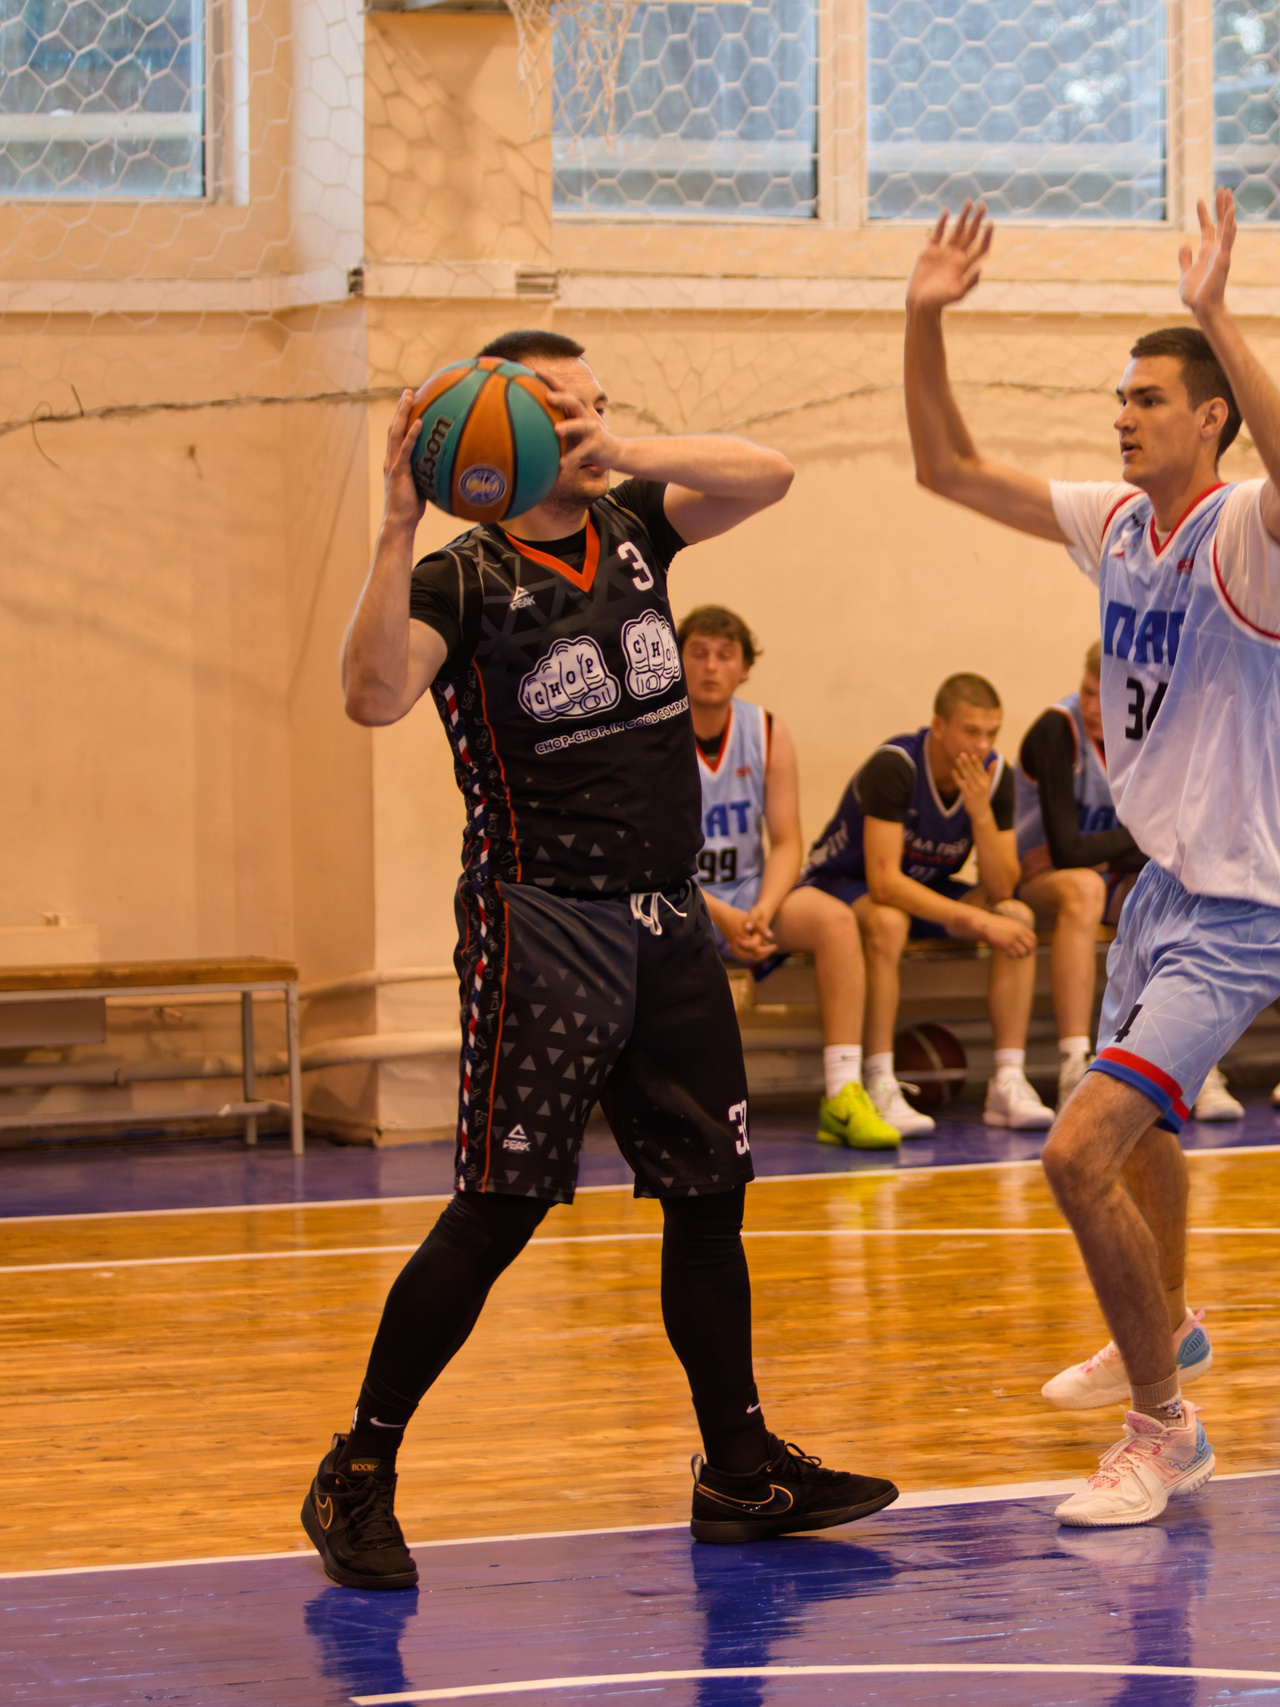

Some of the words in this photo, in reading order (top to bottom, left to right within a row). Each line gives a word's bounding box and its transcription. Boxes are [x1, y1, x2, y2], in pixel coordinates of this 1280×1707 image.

[617, 541, 654, 591] 3
[510, 595, 535, 611] PEAK
[534, 657, 594, 706] CHOP
[610, 721, 625, 734] IN
[625, 710, 659, 729] GOOD
[656, 695, 689, 720] COMPAN
[698, 847, 737, 883] 99
[503, 1139, 531, 1152] PEAK
